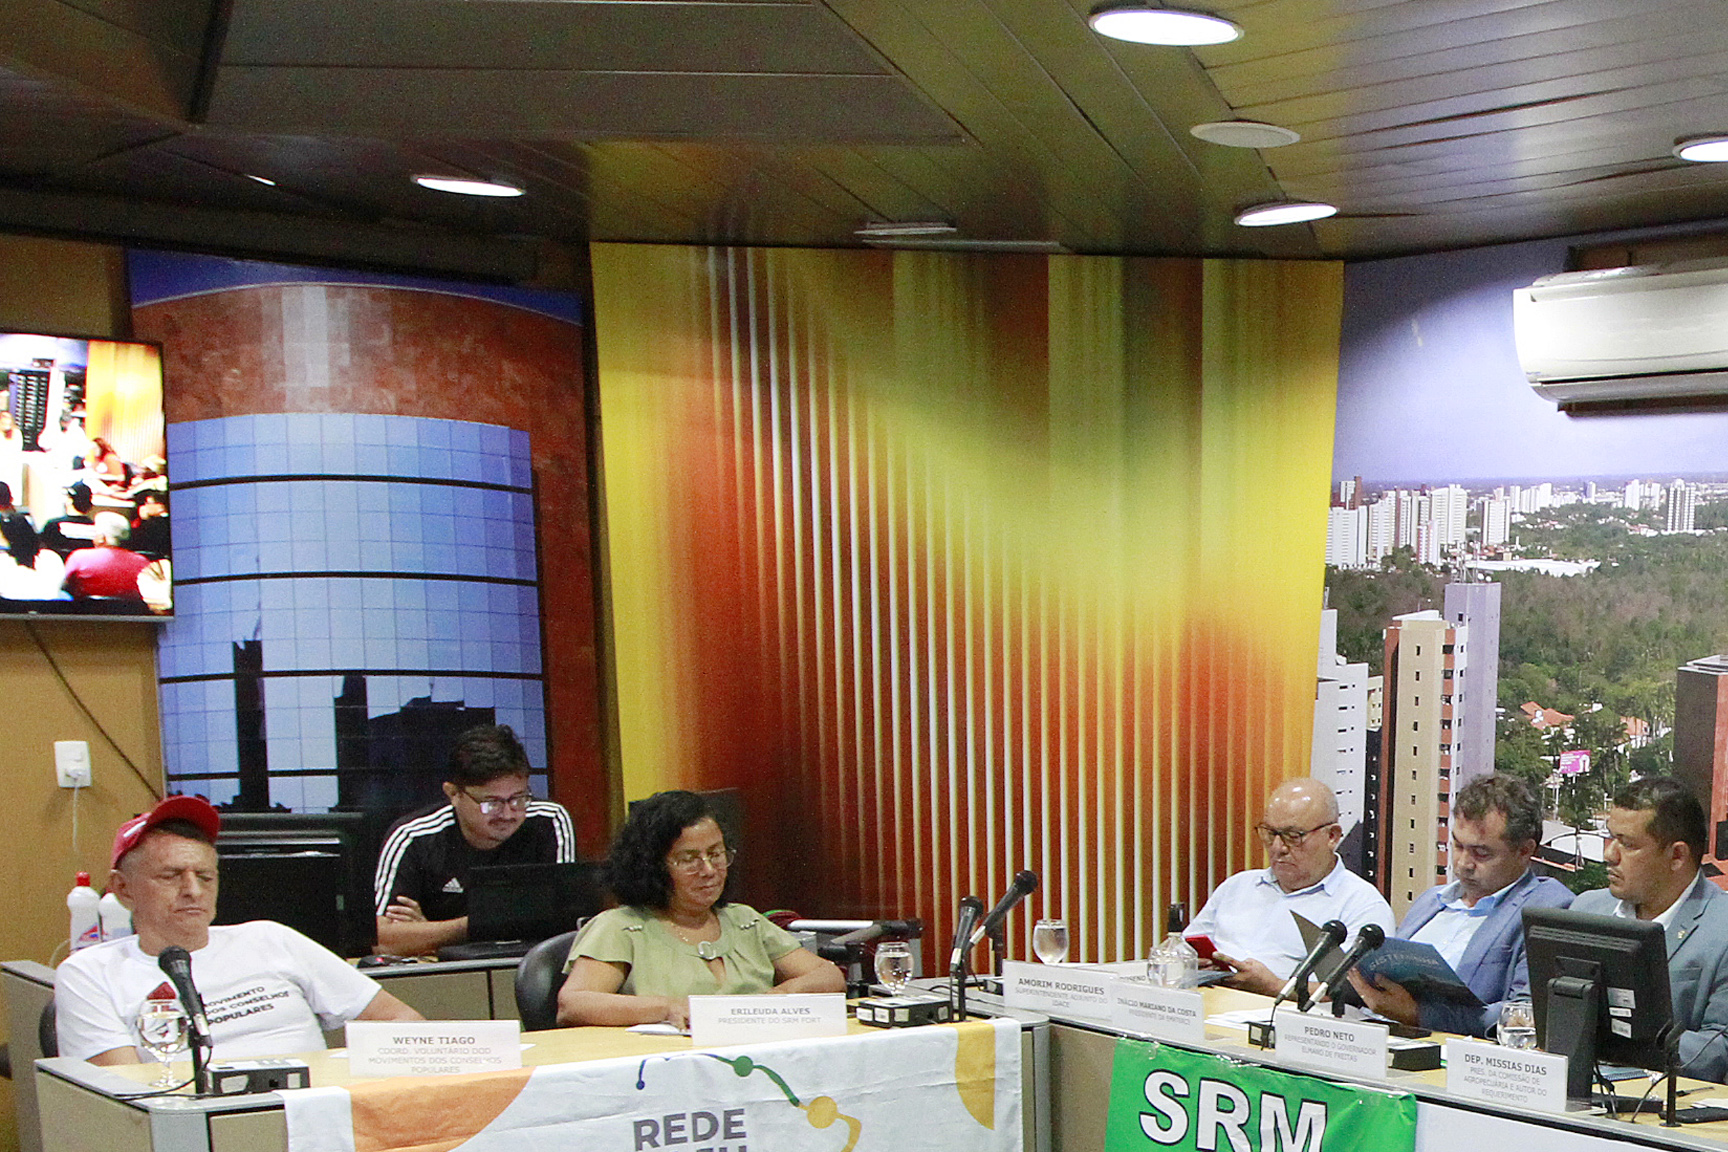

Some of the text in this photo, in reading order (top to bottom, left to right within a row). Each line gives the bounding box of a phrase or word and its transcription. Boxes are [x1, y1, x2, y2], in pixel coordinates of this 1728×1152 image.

[1018, 978, 1104, 995] AMORIM RODRIGUES
[208, 1003, 275, 1025] POPULARES
[1177, 1008, 1196, 1017] COSTA
[393, 1037, 476, 1045] WEYNE TIAGO
[1304, 1026, 1355, 1042] PEDRO NETO
[369, 1057, 425, 1065] MOVIMENTOS
[1465, 1054, 1547, 1075] DEP. MISSIAS DIAS
[1482, 1088, 1528, 1103] REQUERIMENTO
[1516, 1084, 1536, 1094] AUTOR
[1538, 1088, 1547, 1096] DO
[633, 1108, 747, 1151] REDE
